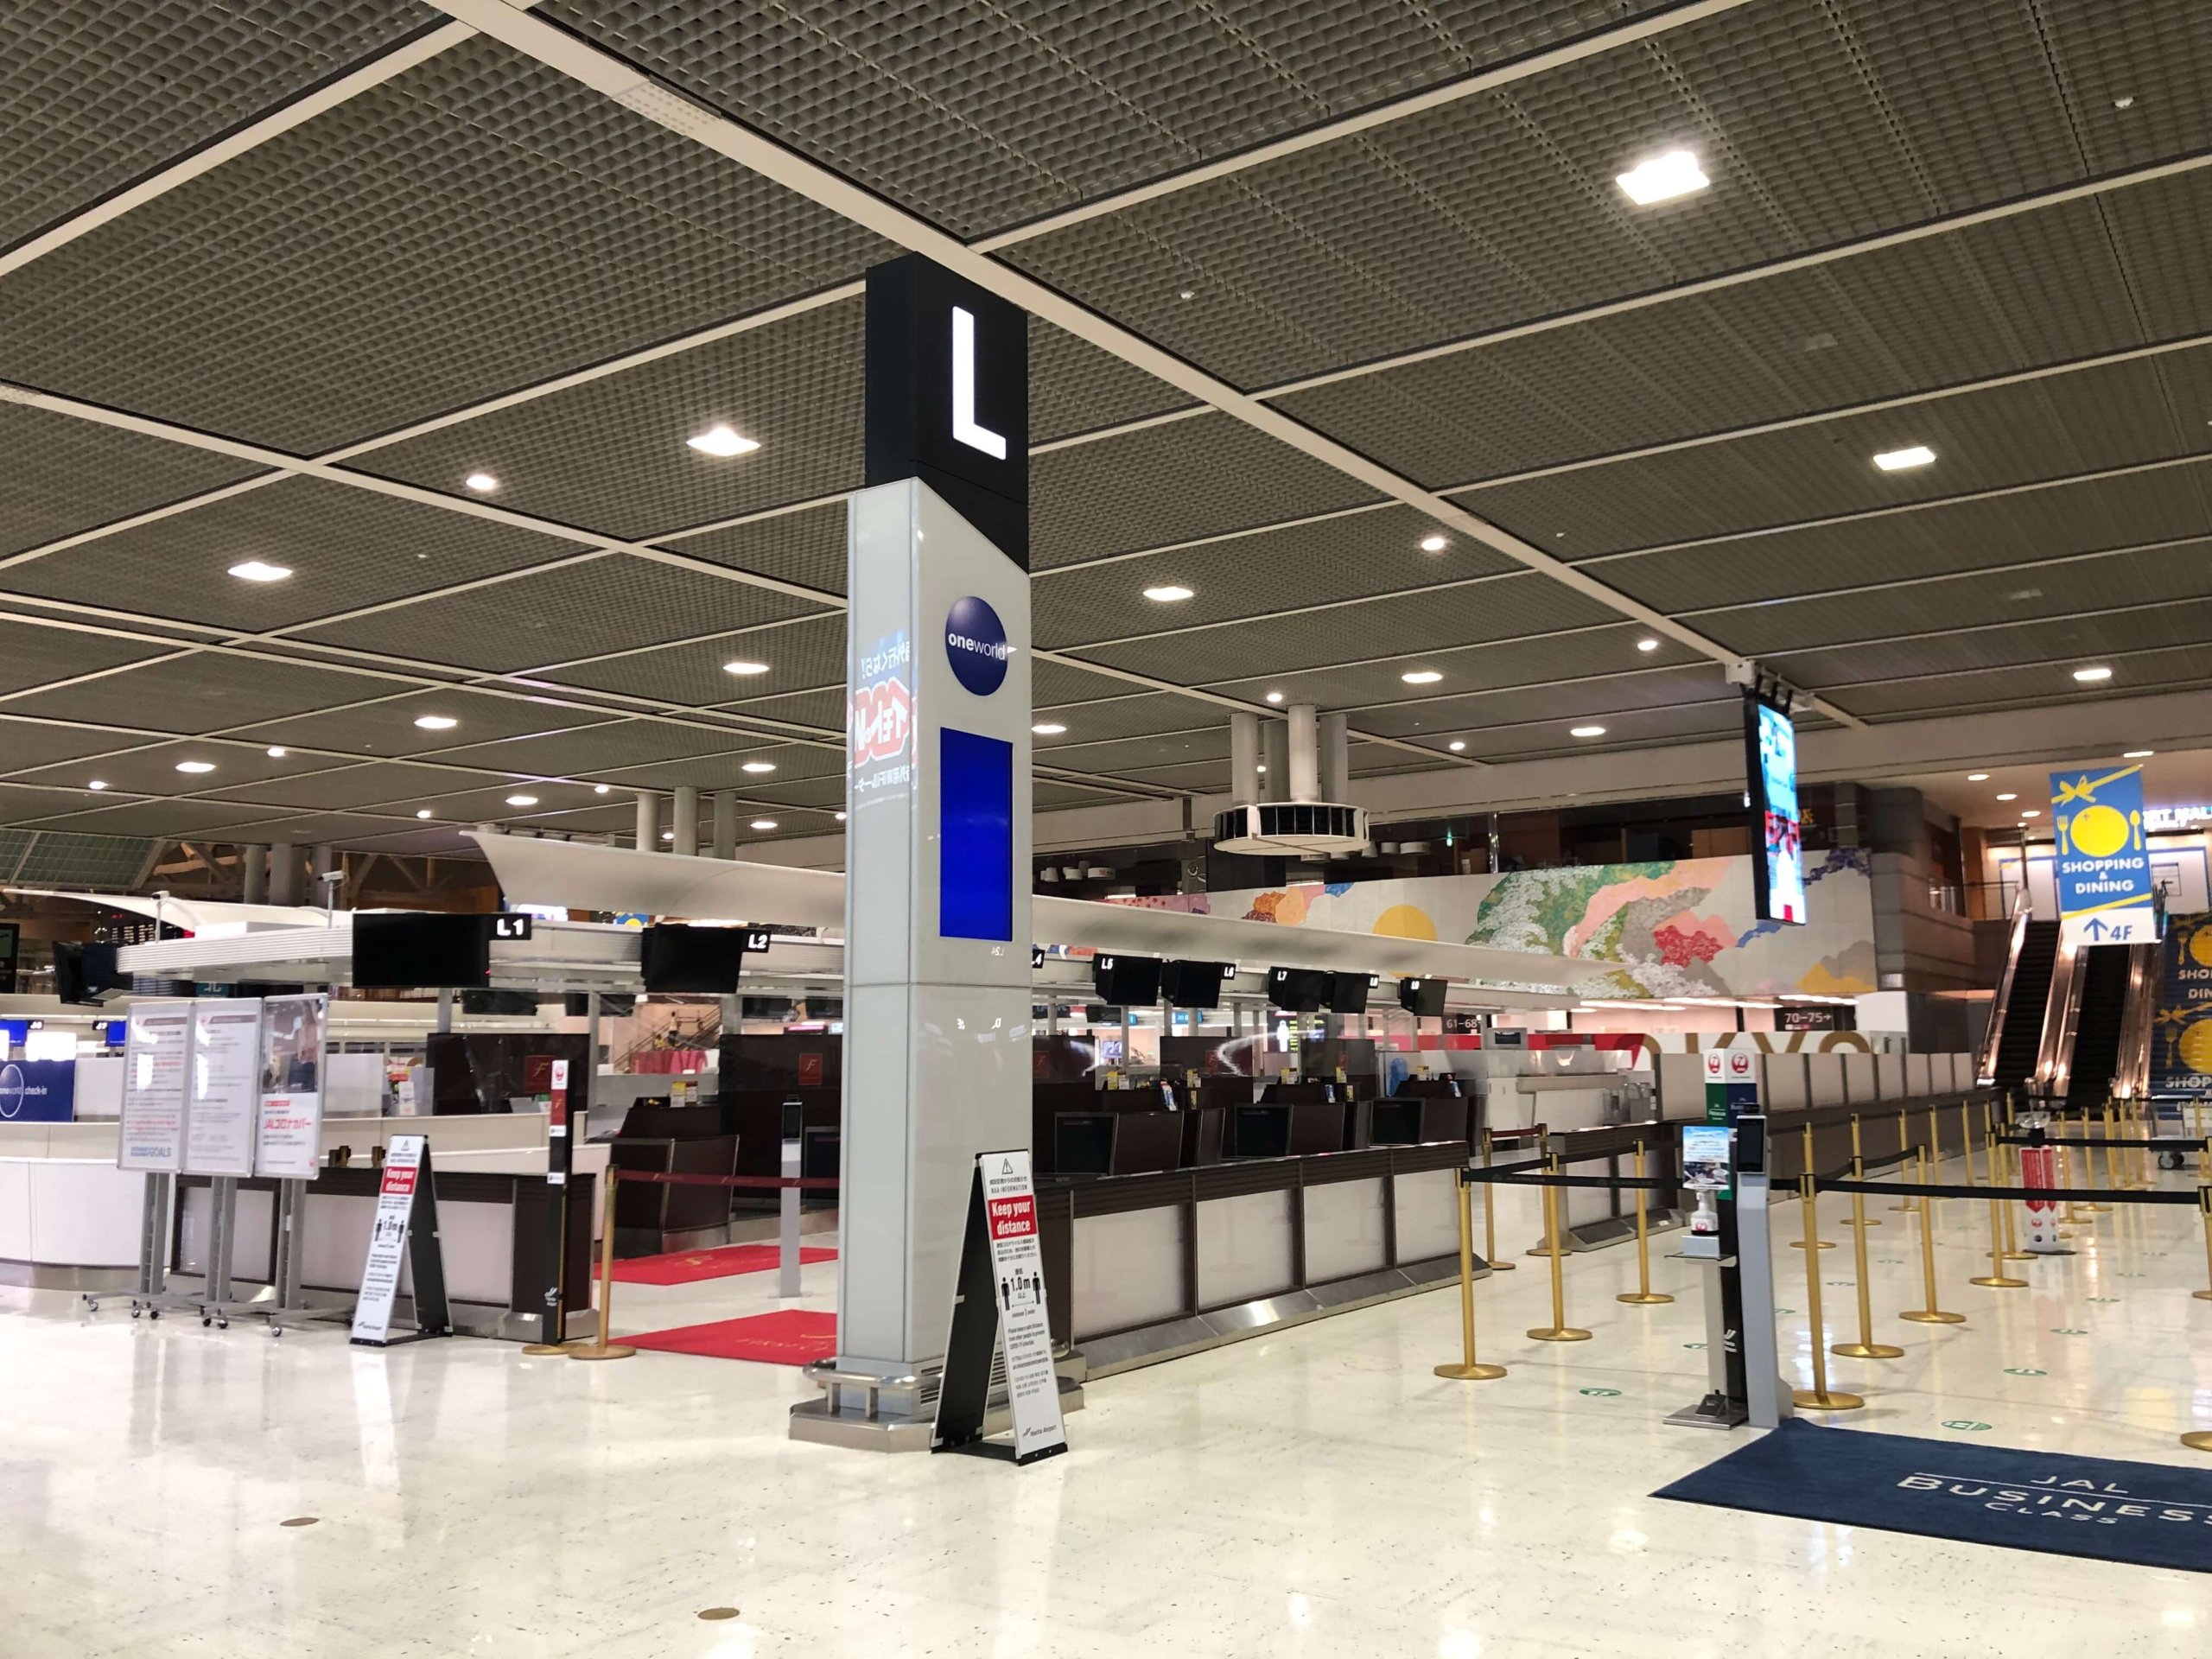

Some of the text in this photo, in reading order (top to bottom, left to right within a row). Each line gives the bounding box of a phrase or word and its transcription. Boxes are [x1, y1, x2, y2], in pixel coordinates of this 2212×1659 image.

[951, 306, 1007, 461] L
[948, 632, 1006, 660] oneworld
[2062, 857, 2145, 874] SHOPPING
[2099, 871, 2108, 880] &
[2075, 880, 2135, 894] DINING
[497, 918, 524, 936] L1
[2110, 925, 2133, 940] 4F
[748, 934, 768, 949] L2
[2178, 969, 2212, 980] SHO
[991, 1200, 1031, 1218] Keep your
[996, 1219, 1031, 1236] distance
[2031, 1476, 2129, 1494] JAL
[1897, 1476, 2212, 1526] BUSINES
[1985, 1502, 2119, 1525] CLASS
